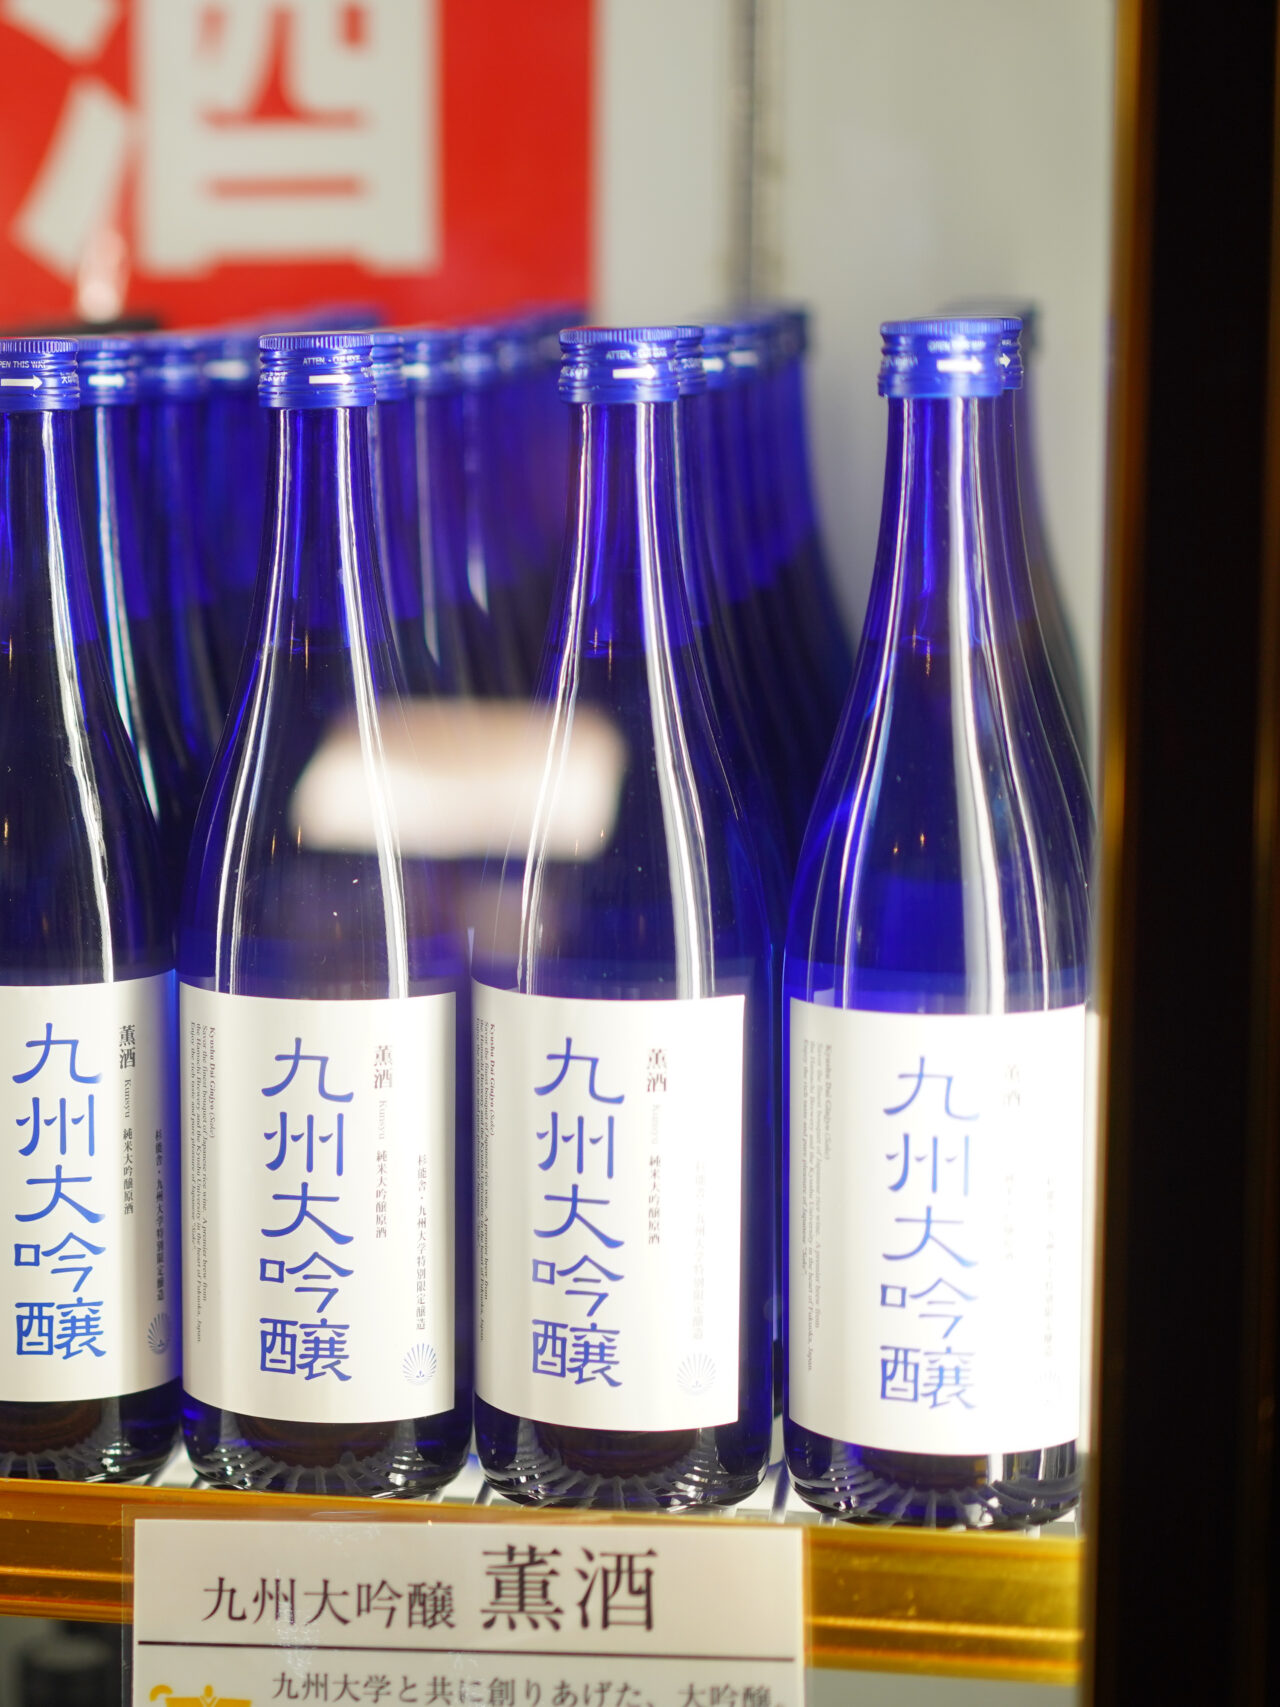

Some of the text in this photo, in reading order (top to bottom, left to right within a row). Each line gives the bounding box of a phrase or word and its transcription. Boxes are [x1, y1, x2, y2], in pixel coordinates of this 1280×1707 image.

[12, 360, 30, 369] THIS
[119, 1025, 136, 1069] 薫酒
[208, 1027, 216, 1060] Kyushu
[208, 1080, 216, 1110] Ginjyo
[208, 1112, 216, 1138] (Sake)
[12, 1022, 106, 1360] 九州大吟醸
[260, 1037, 354, 1382] 九州大吟醸
[532, 1037, 625, 1387] 九州大吟醸
[880, 1056, 979, 1410] 九州大吟醸
[202, 1544, 658, 1632] 九州大吟醸 薫酒
[272, 1671, 784, 1707] 九州大学と共に創りあげた、大吟醸
